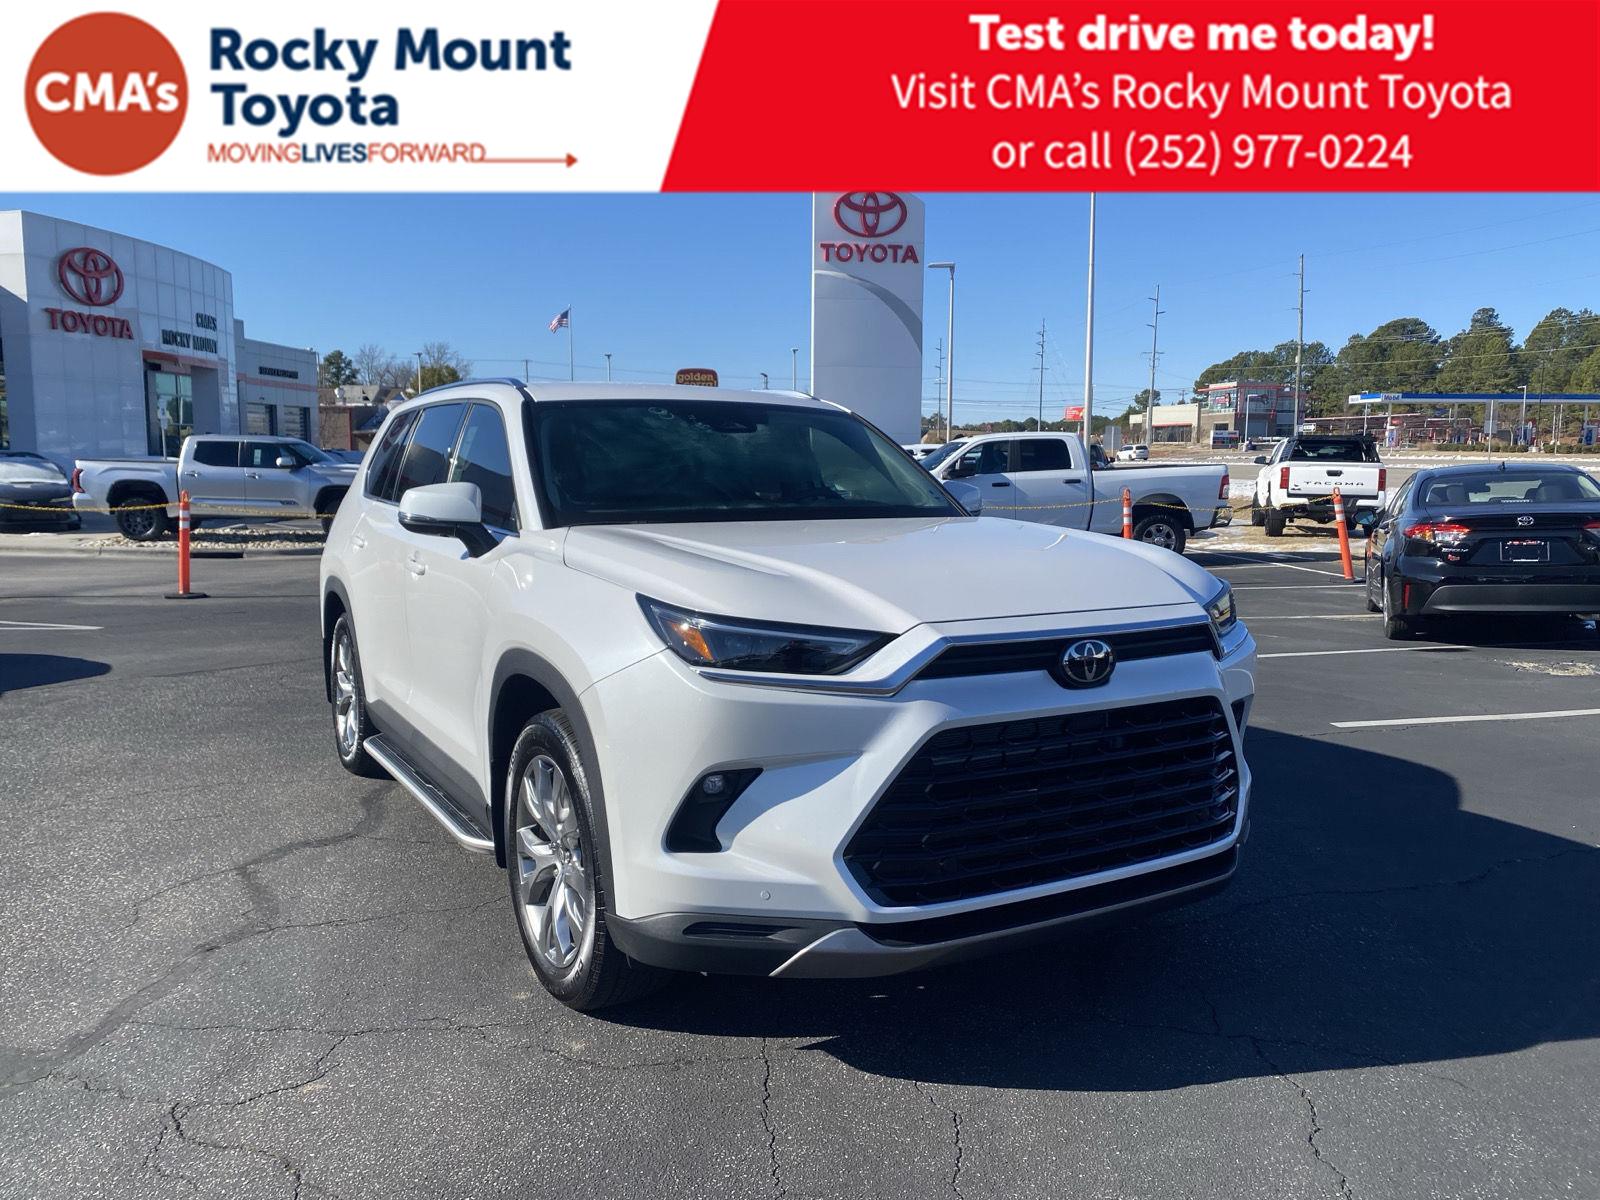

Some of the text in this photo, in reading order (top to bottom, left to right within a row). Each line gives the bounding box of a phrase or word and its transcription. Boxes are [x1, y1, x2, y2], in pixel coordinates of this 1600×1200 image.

[820, 243, 919, 264] TOYOTA
[44, 307, 134, 340] TOYOTA
[161, 329, 217, 354] ROCKY MOUNT
[677, 372, 714, 383] golden
